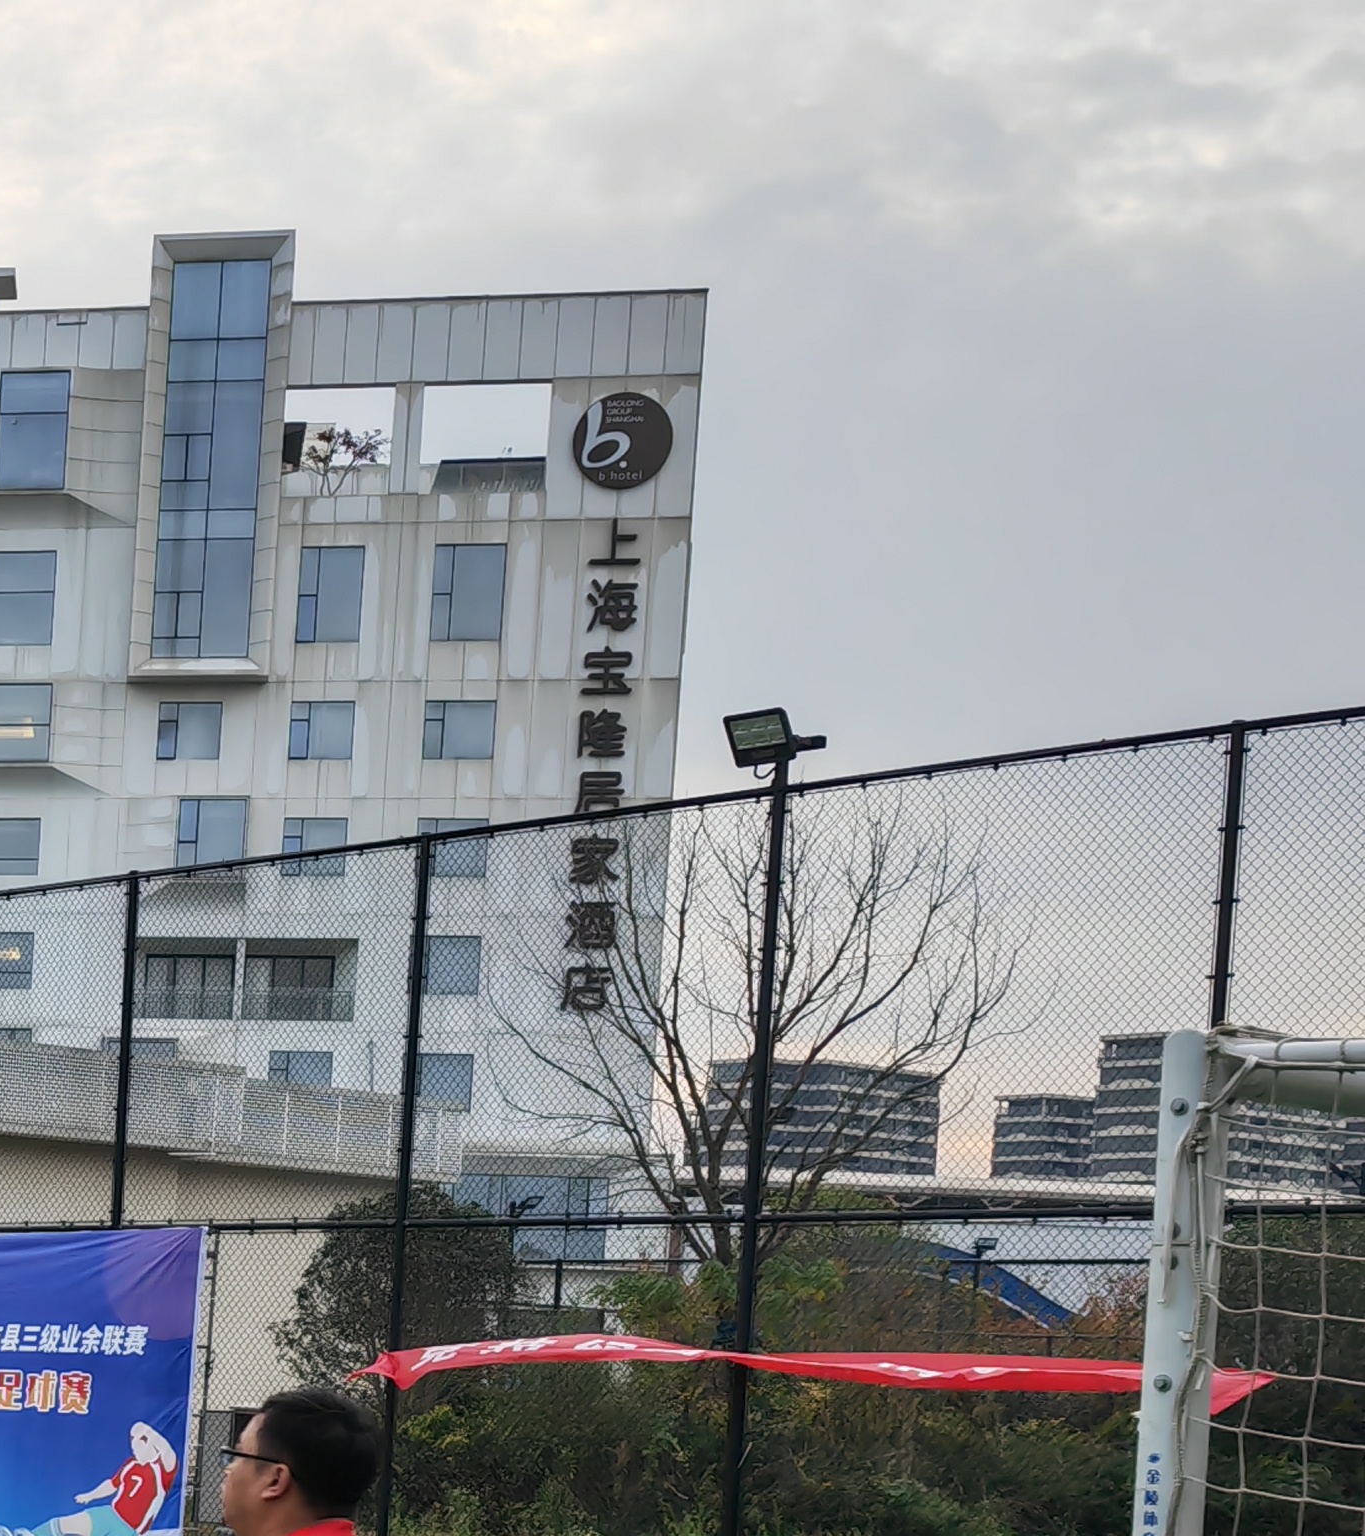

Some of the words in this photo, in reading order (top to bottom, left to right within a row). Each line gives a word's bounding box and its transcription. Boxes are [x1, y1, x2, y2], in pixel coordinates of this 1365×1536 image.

[610, 470, 643, 480] hotel
[560, 518, 641, 1012] 上海宝隆居家酒店
[129, 1475, 143, 1498] 7
